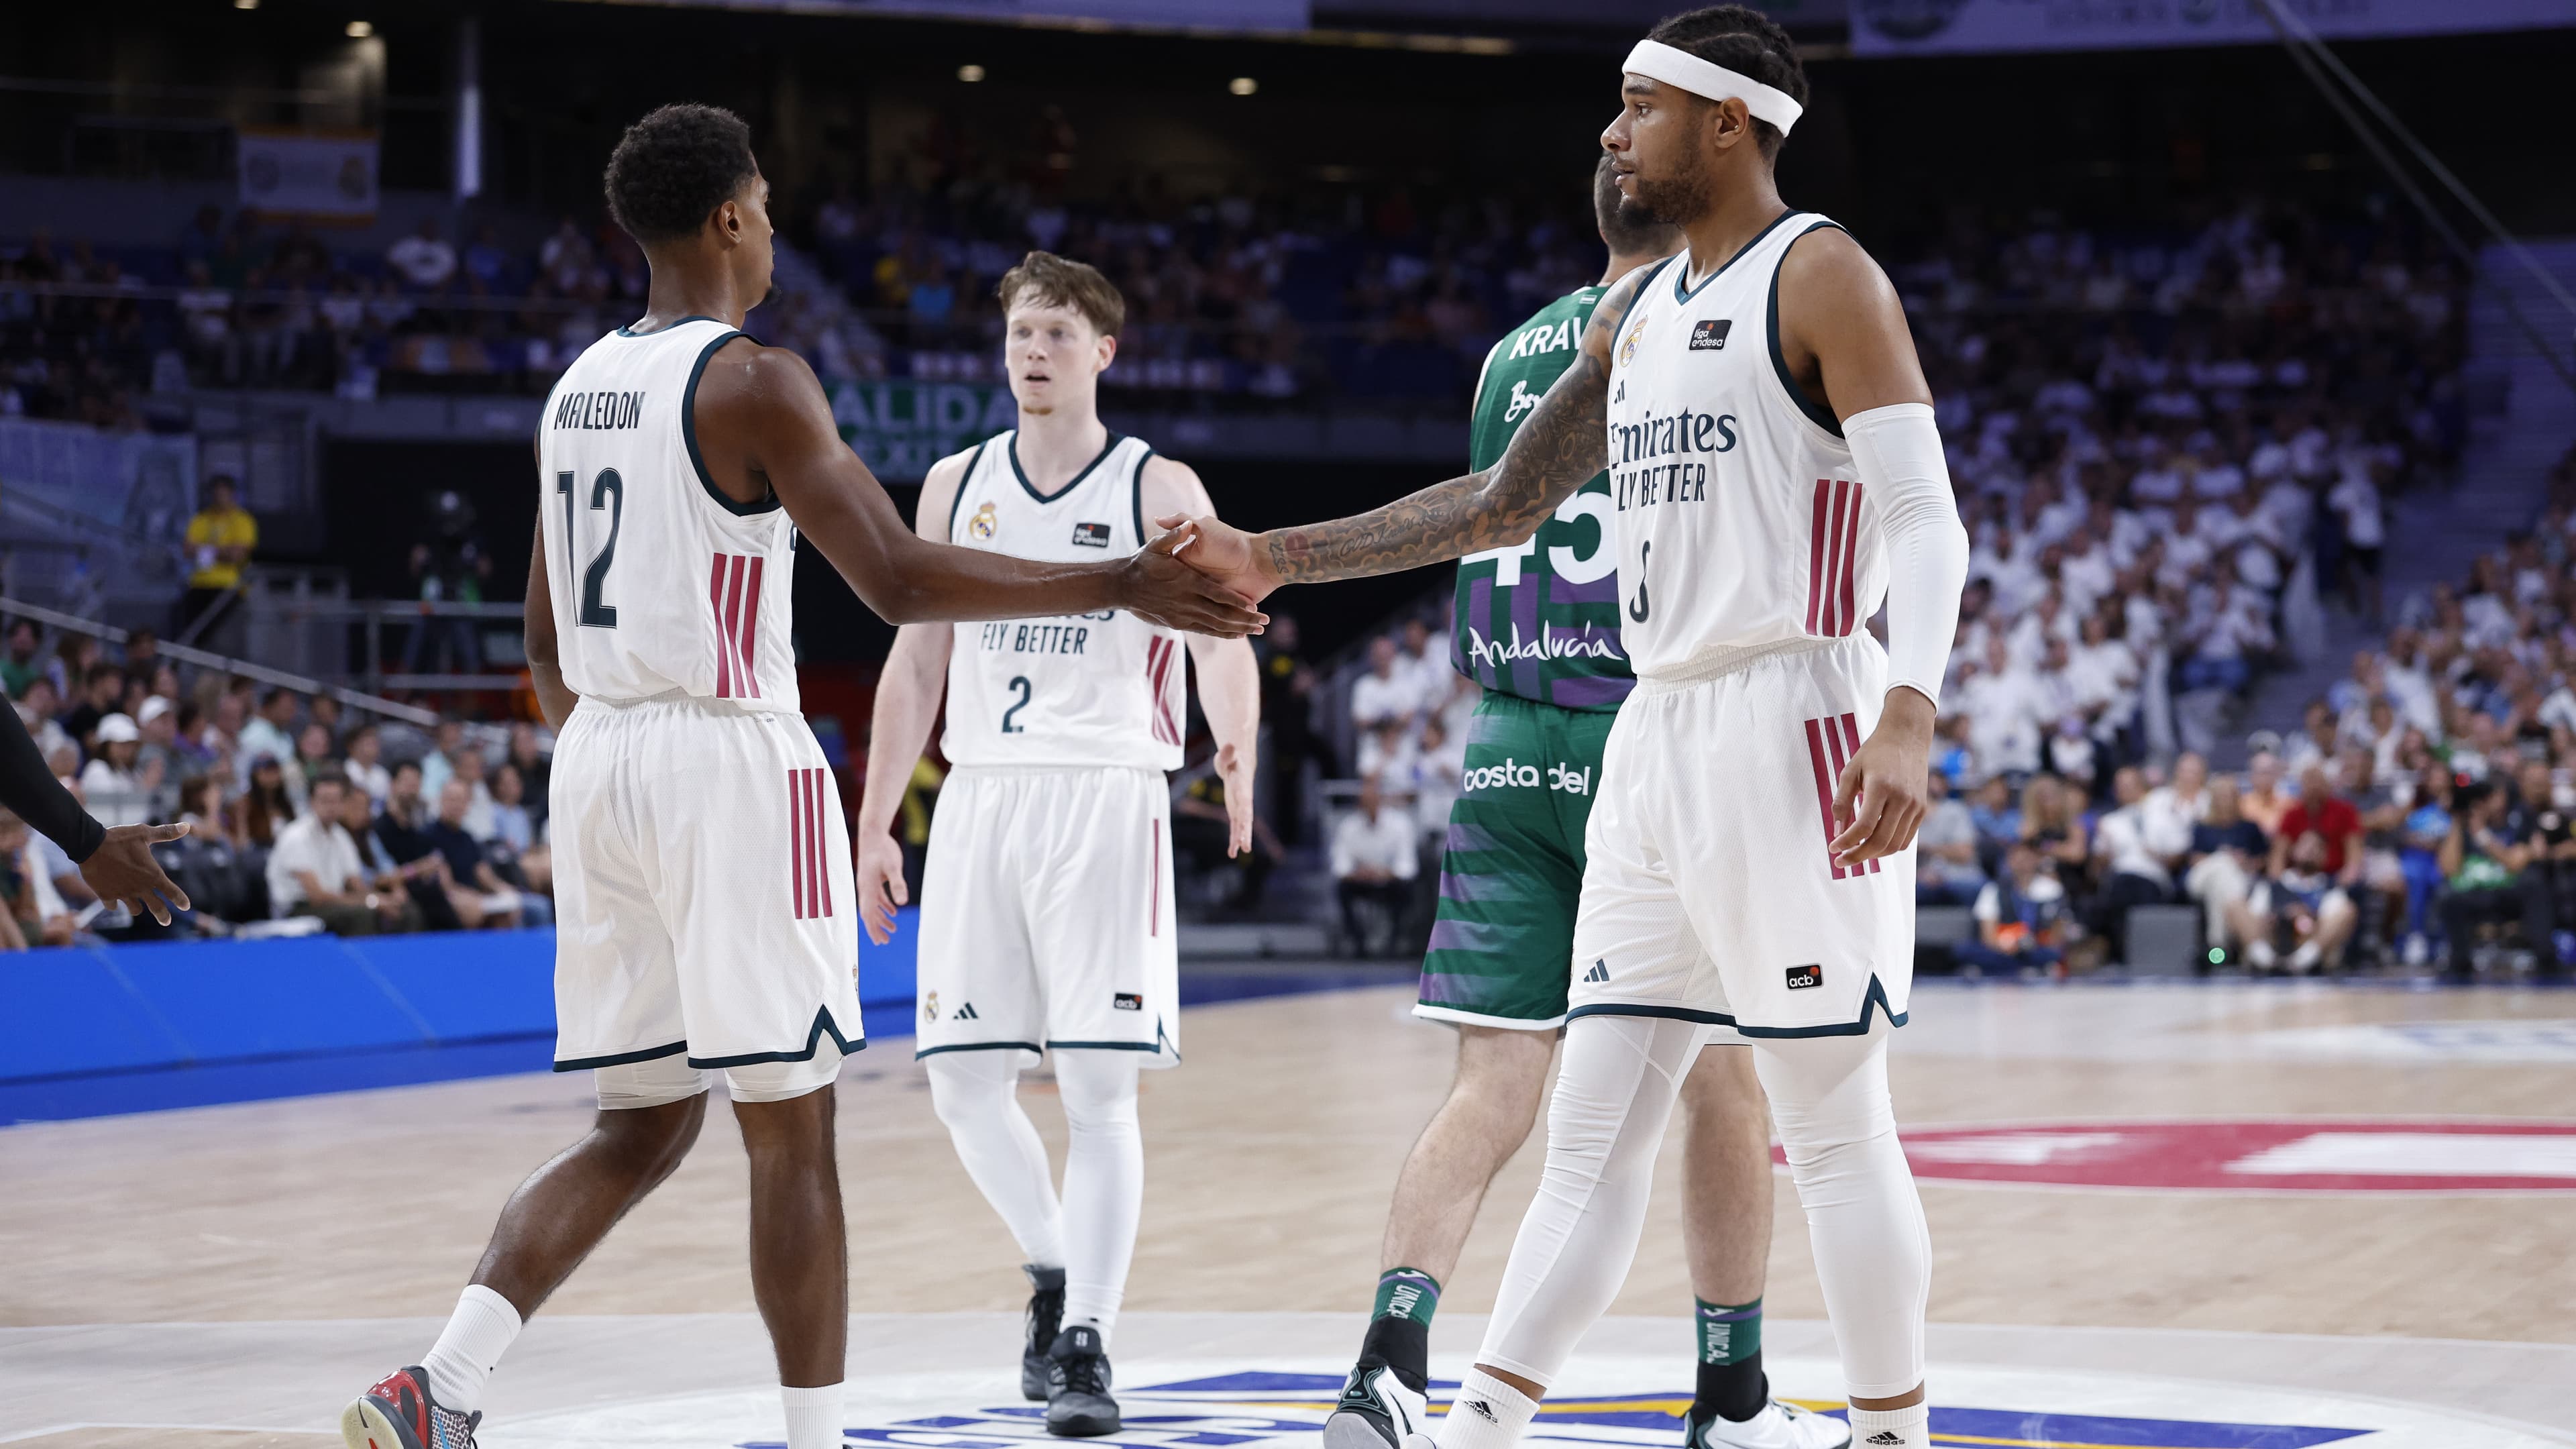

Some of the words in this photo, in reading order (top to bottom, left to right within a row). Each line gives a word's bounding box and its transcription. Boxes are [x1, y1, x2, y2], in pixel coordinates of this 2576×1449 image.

[1509, 317, 1584, 360] KRAV
[1691, 337, 1723, 347] endesa
[1694, 329, 1710, 339] liga
[553, 391, 646, 430] MALEDON
[830, 382, 1018, 431] ALIDA
[1610, 407, 1737, 470] Emirates
[1616, 472, 1638, 512] LY
[557, 467, 624, 630] 12
[981, 623, 1008, 650] FLY
[1014, 625, 1088, 654] BETTER
[1467, 619, 1624, 667] Andalucía
[1002, 676, 1031, 733] 2
[1464, 757, 1540, 792] costa
[1547, 761, 1591, 796] del
[1788, 973, 1814, 987] acb
[1386, 1284, 1421, 1320] UNICA
[1866, 1438, 1906, 1446] adidas
